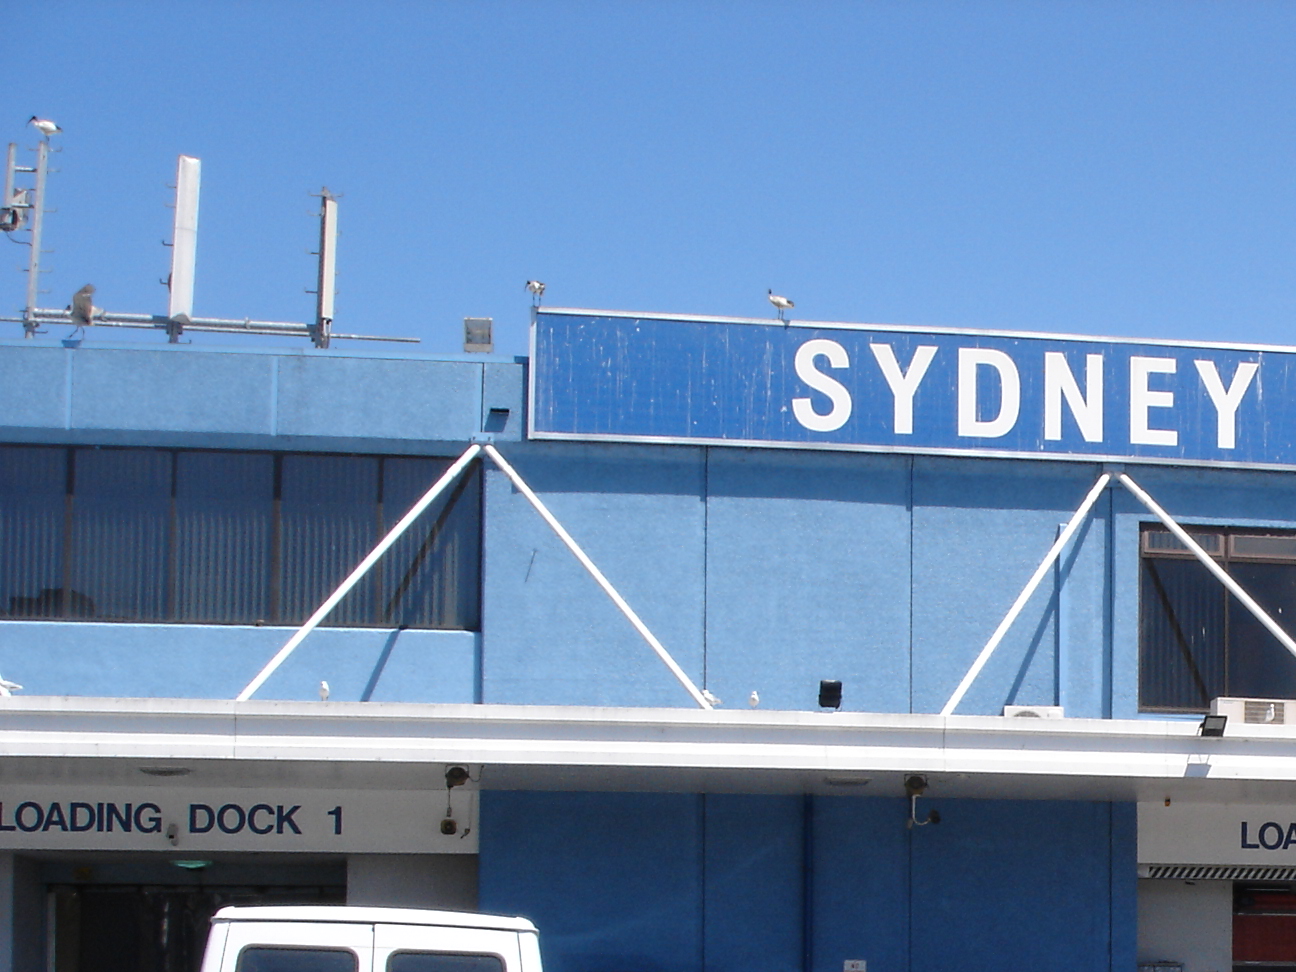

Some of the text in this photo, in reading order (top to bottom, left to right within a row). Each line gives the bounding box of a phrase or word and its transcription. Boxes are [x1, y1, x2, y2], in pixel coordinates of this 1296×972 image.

[791, 338, 1260, 449] SYDNEY
[0, 801, 343, 836] LOADING DOCK 1
